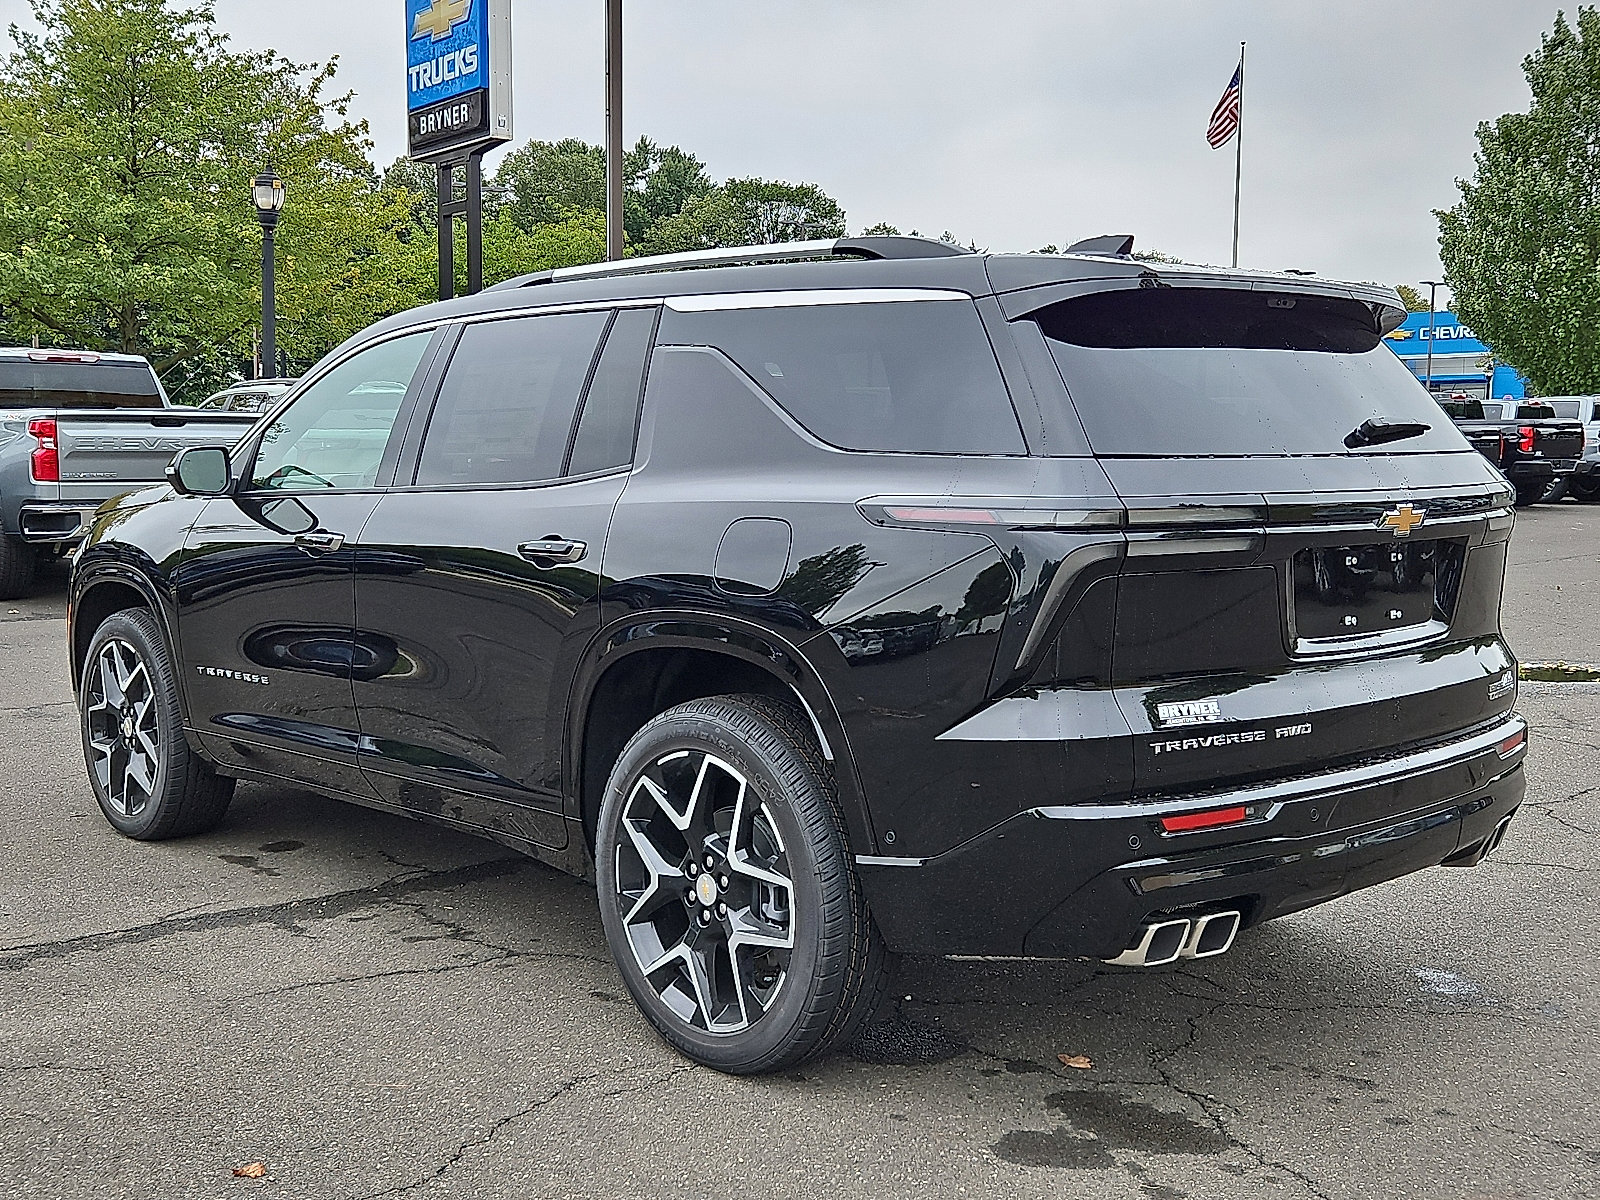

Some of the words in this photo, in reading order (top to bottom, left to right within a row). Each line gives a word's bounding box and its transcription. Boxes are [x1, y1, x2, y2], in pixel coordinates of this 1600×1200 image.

[409, 44, 478, 92] TRUCKS
[420, 103, 469, 135] BRYNER
[196, 666, 270, 685] TRAVERSE
[1157, 701, 1220, 718] BRYNER
[1150, 730, 1266, 755] TRAVERSE
[1274, 723, 1312, 739] AWD
